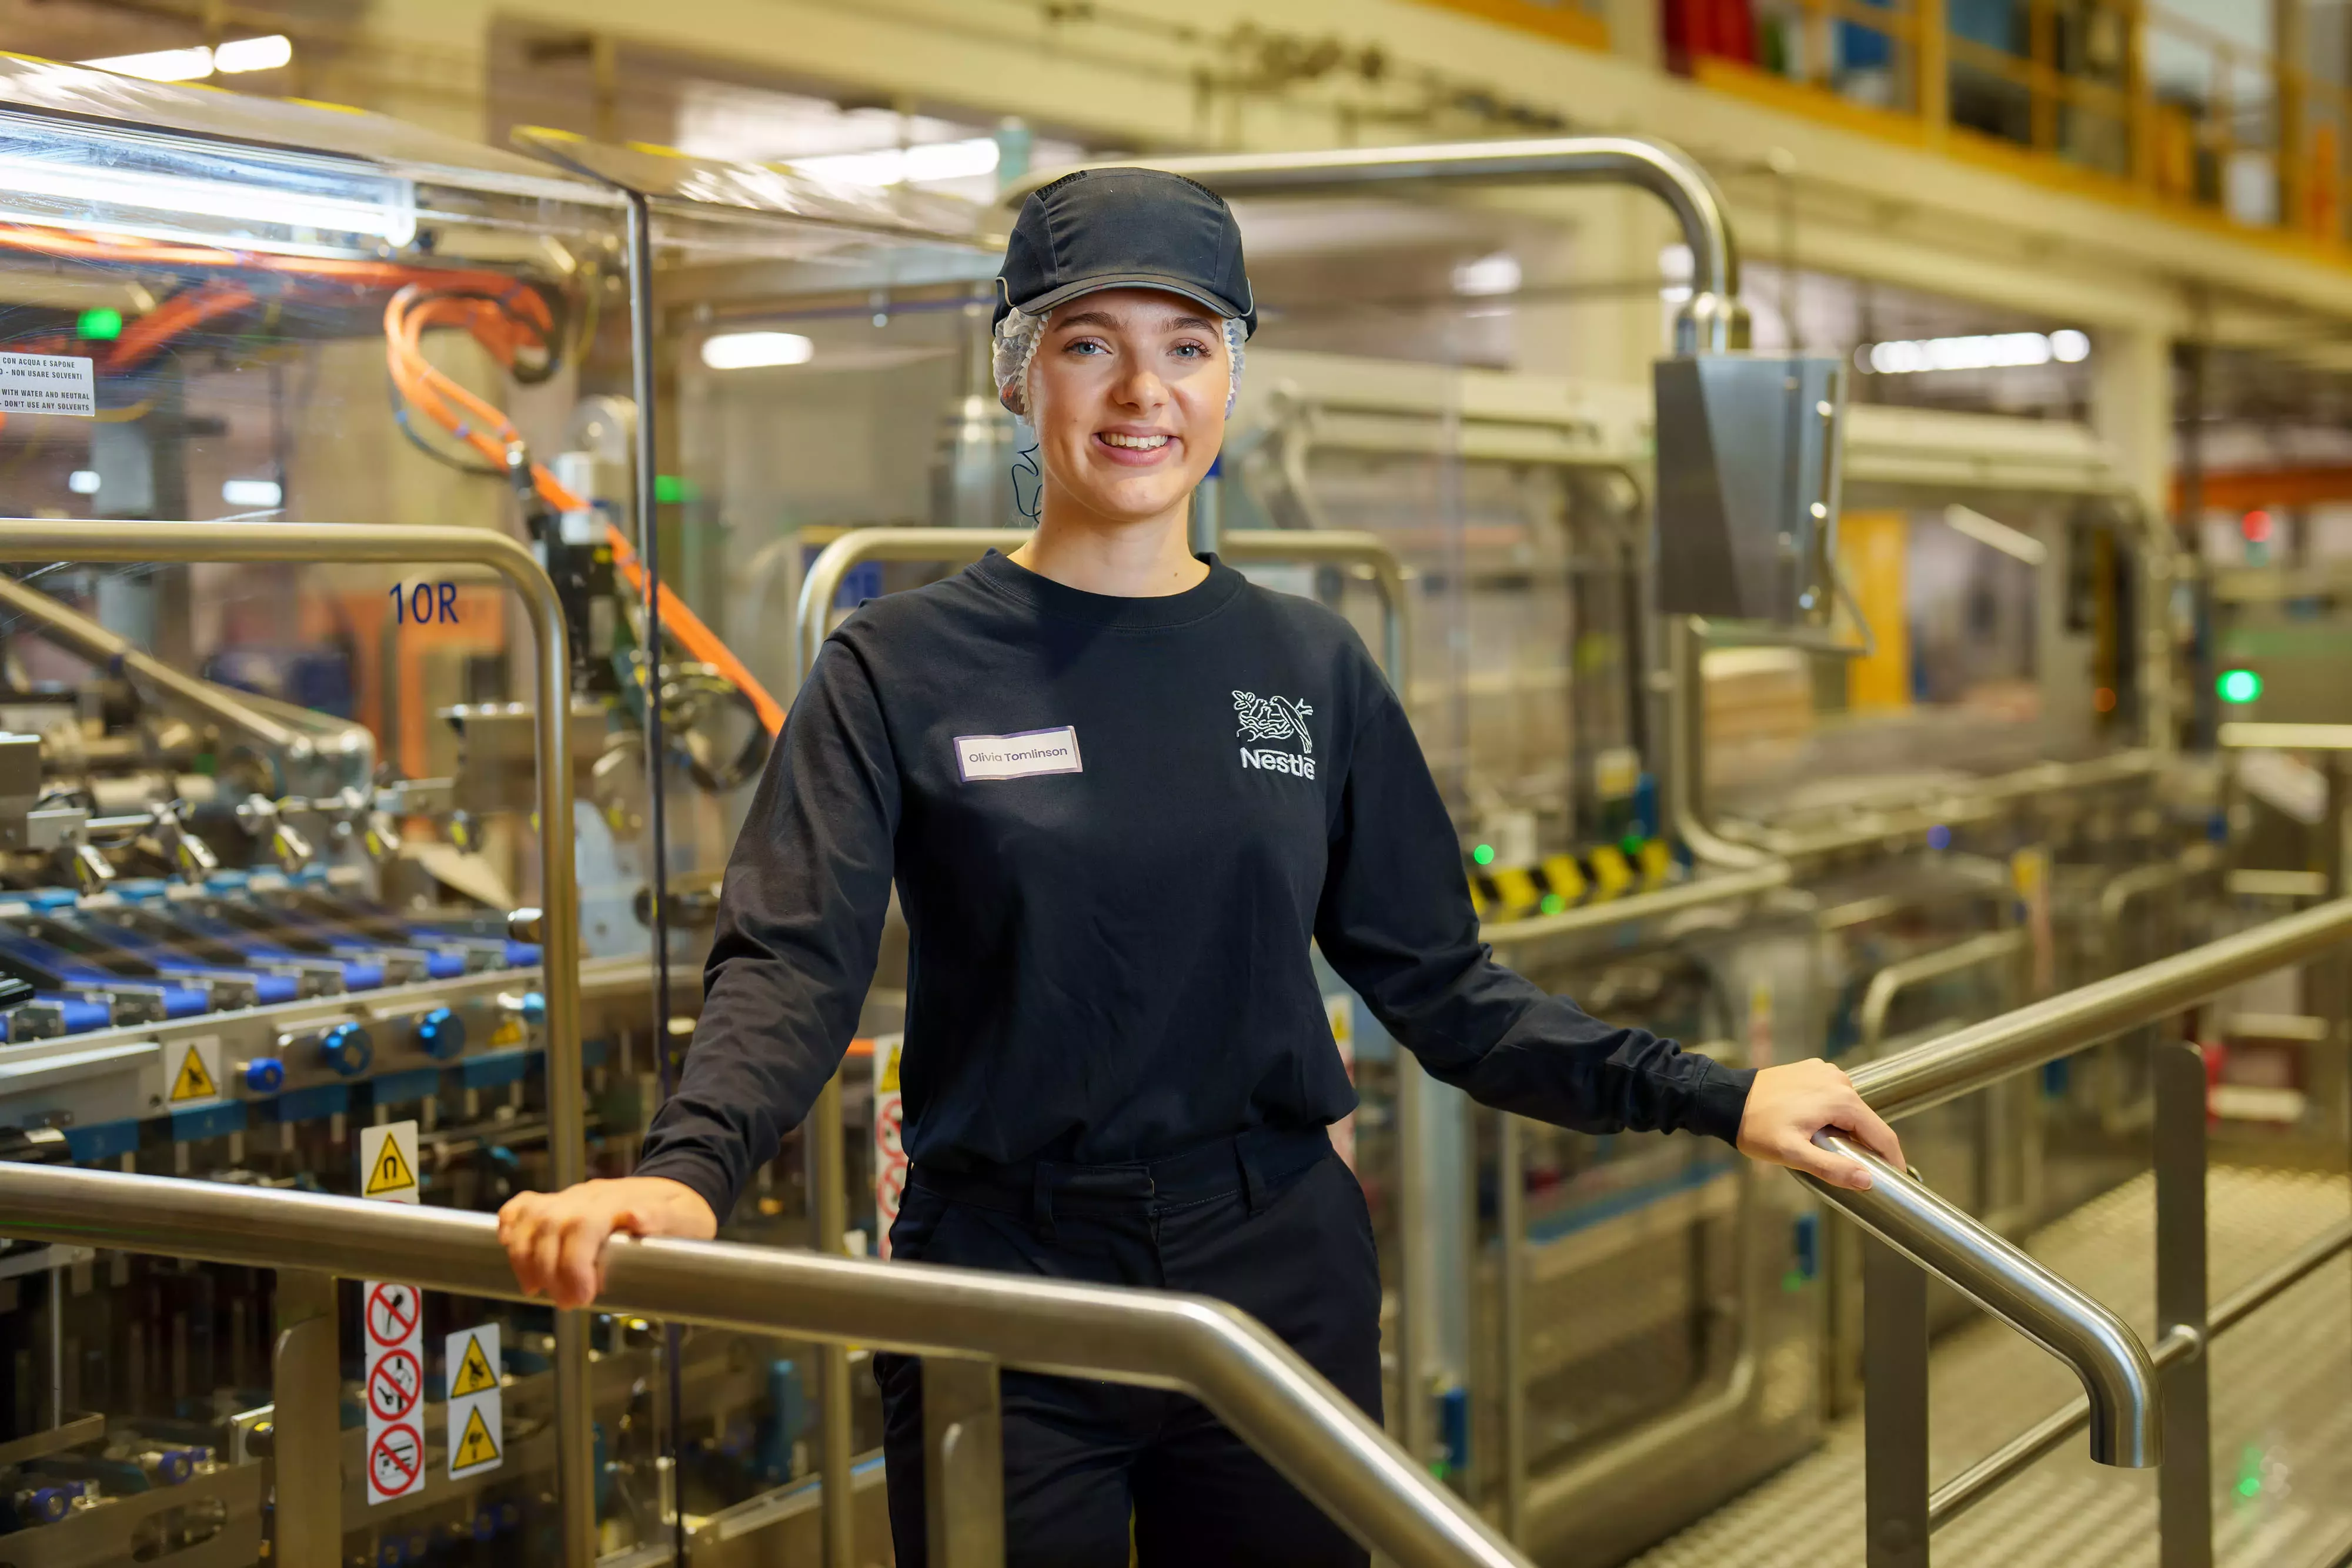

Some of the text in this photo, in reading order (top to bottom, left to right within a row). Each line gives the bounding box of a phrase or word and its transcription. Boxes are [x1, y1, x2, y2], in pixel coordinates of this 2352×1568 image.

[52, 372, 82, 380] SOLVENTI
[389, 582, 460, 625] 10R
[968, 747, 1068, 763] Olivia Tomlinson
